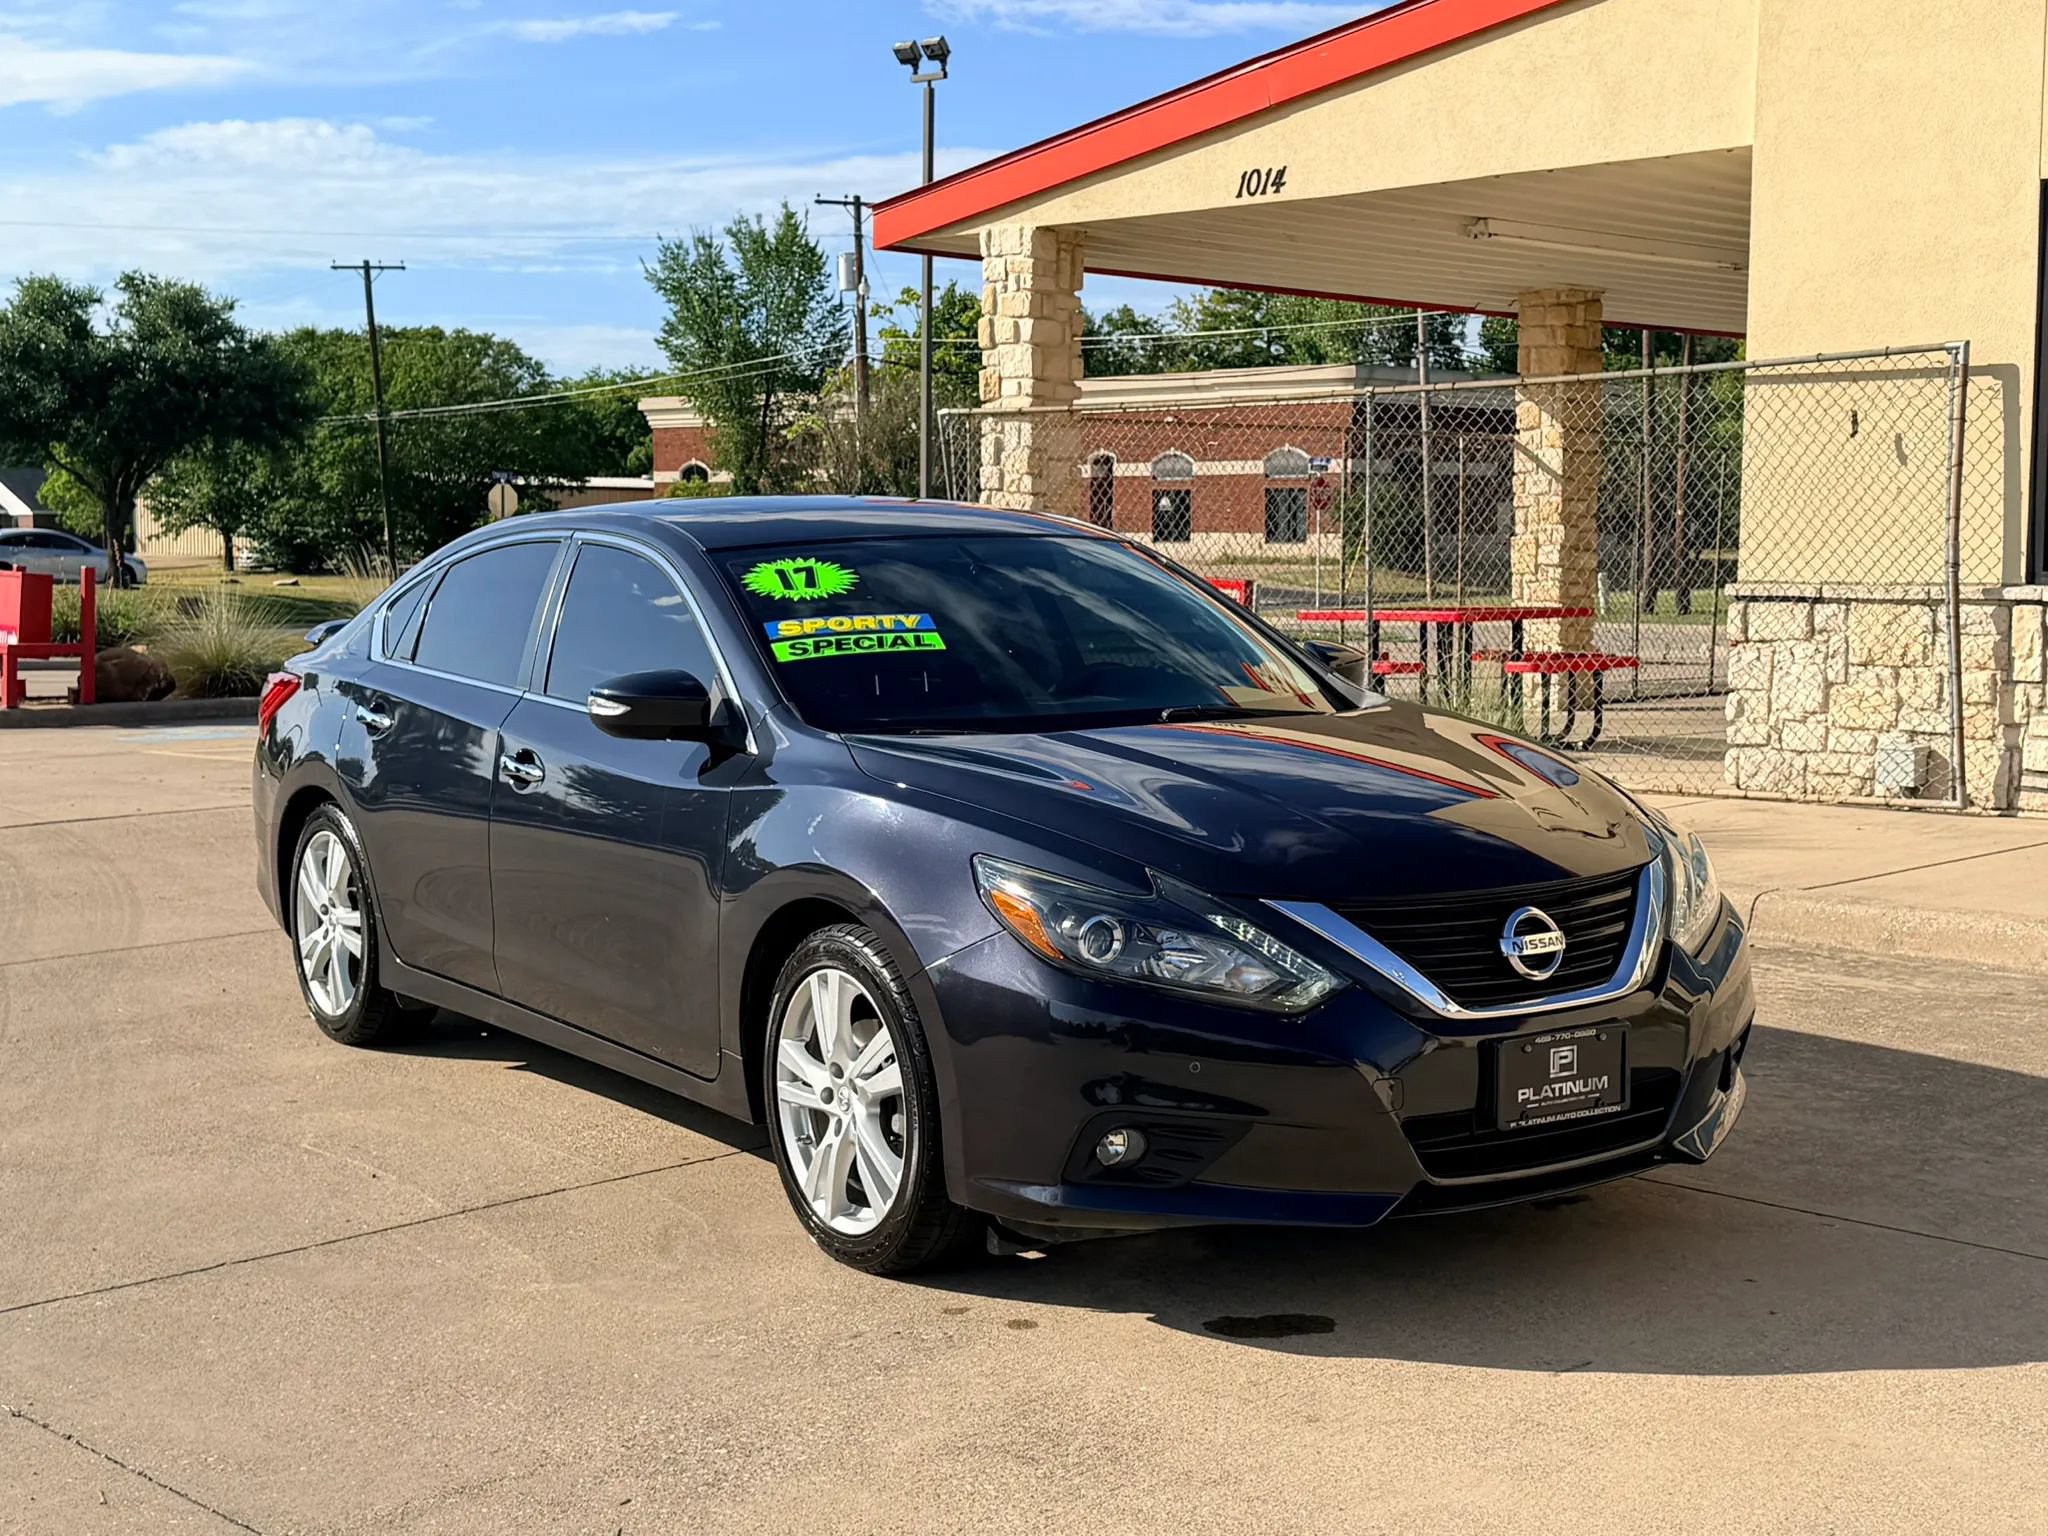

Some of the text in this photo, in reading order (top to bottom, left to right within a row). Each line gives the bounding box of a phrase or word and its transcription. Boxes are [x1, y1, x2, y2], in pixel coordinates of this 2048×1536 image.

[1235, 165, 1287, 198] 1014
[774, 565, 821, 591] 17
[777, 614, 922, 636] SPORTY
[788, 634, 936, 656] SPECIAL
[1511, 932, 1564, 953] NISSAN
[1518, 1075, 1608, 1103] PLATINUM
[1555, 1111, 1577, 1121] AUTO
[1576, 1105, 1621, 1118] COLLECTION
